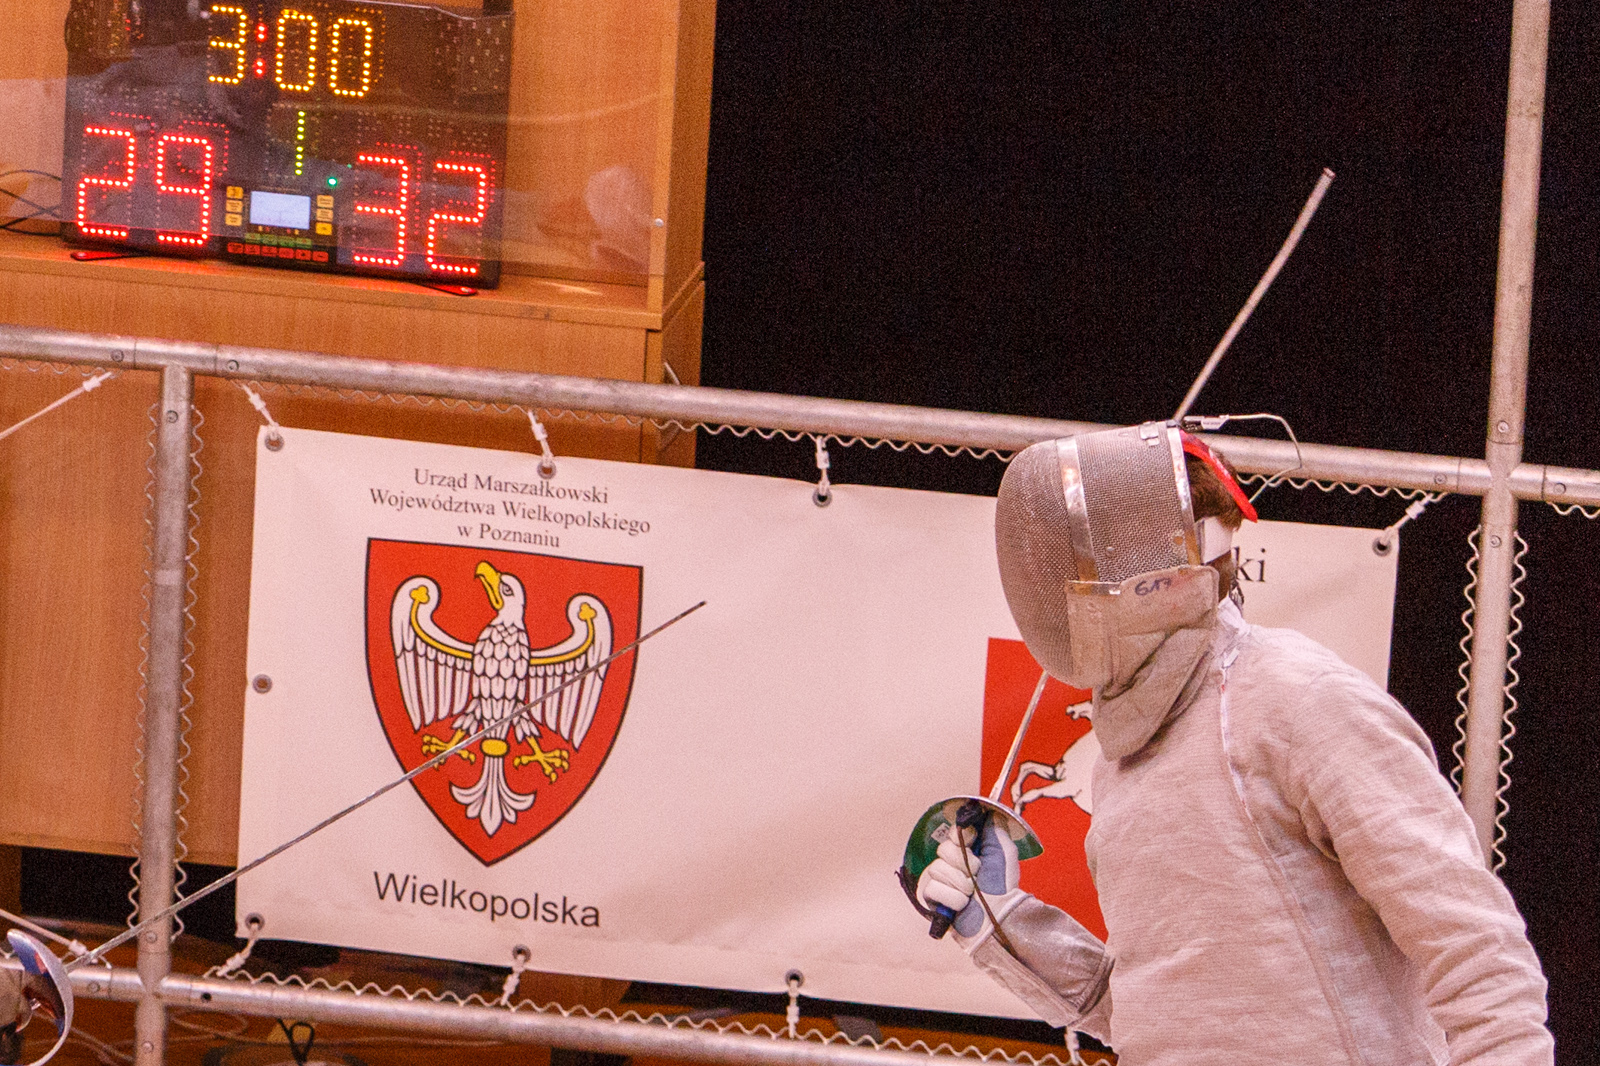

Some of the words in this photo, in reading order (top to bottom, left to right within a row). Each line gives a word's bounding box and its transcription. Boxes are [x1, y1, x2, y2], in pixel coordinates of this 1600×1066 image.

[208, 4, 373, 97] 3:00
[77, 126, 213, 246] 29
[353, 154, 487, 275] 32
[370, 488, 496, 516] Województwa
[503, 501, 651, 537] Wielkopolskiego
[414, 468, 468, 492] Urząd
[474, 474, 609, 504] Marszałkowski
[457, 525, 473, 538] w
[479, 524, 560, 548] Poznaniu
[374, 871, 600, 928] Wielkopolska
